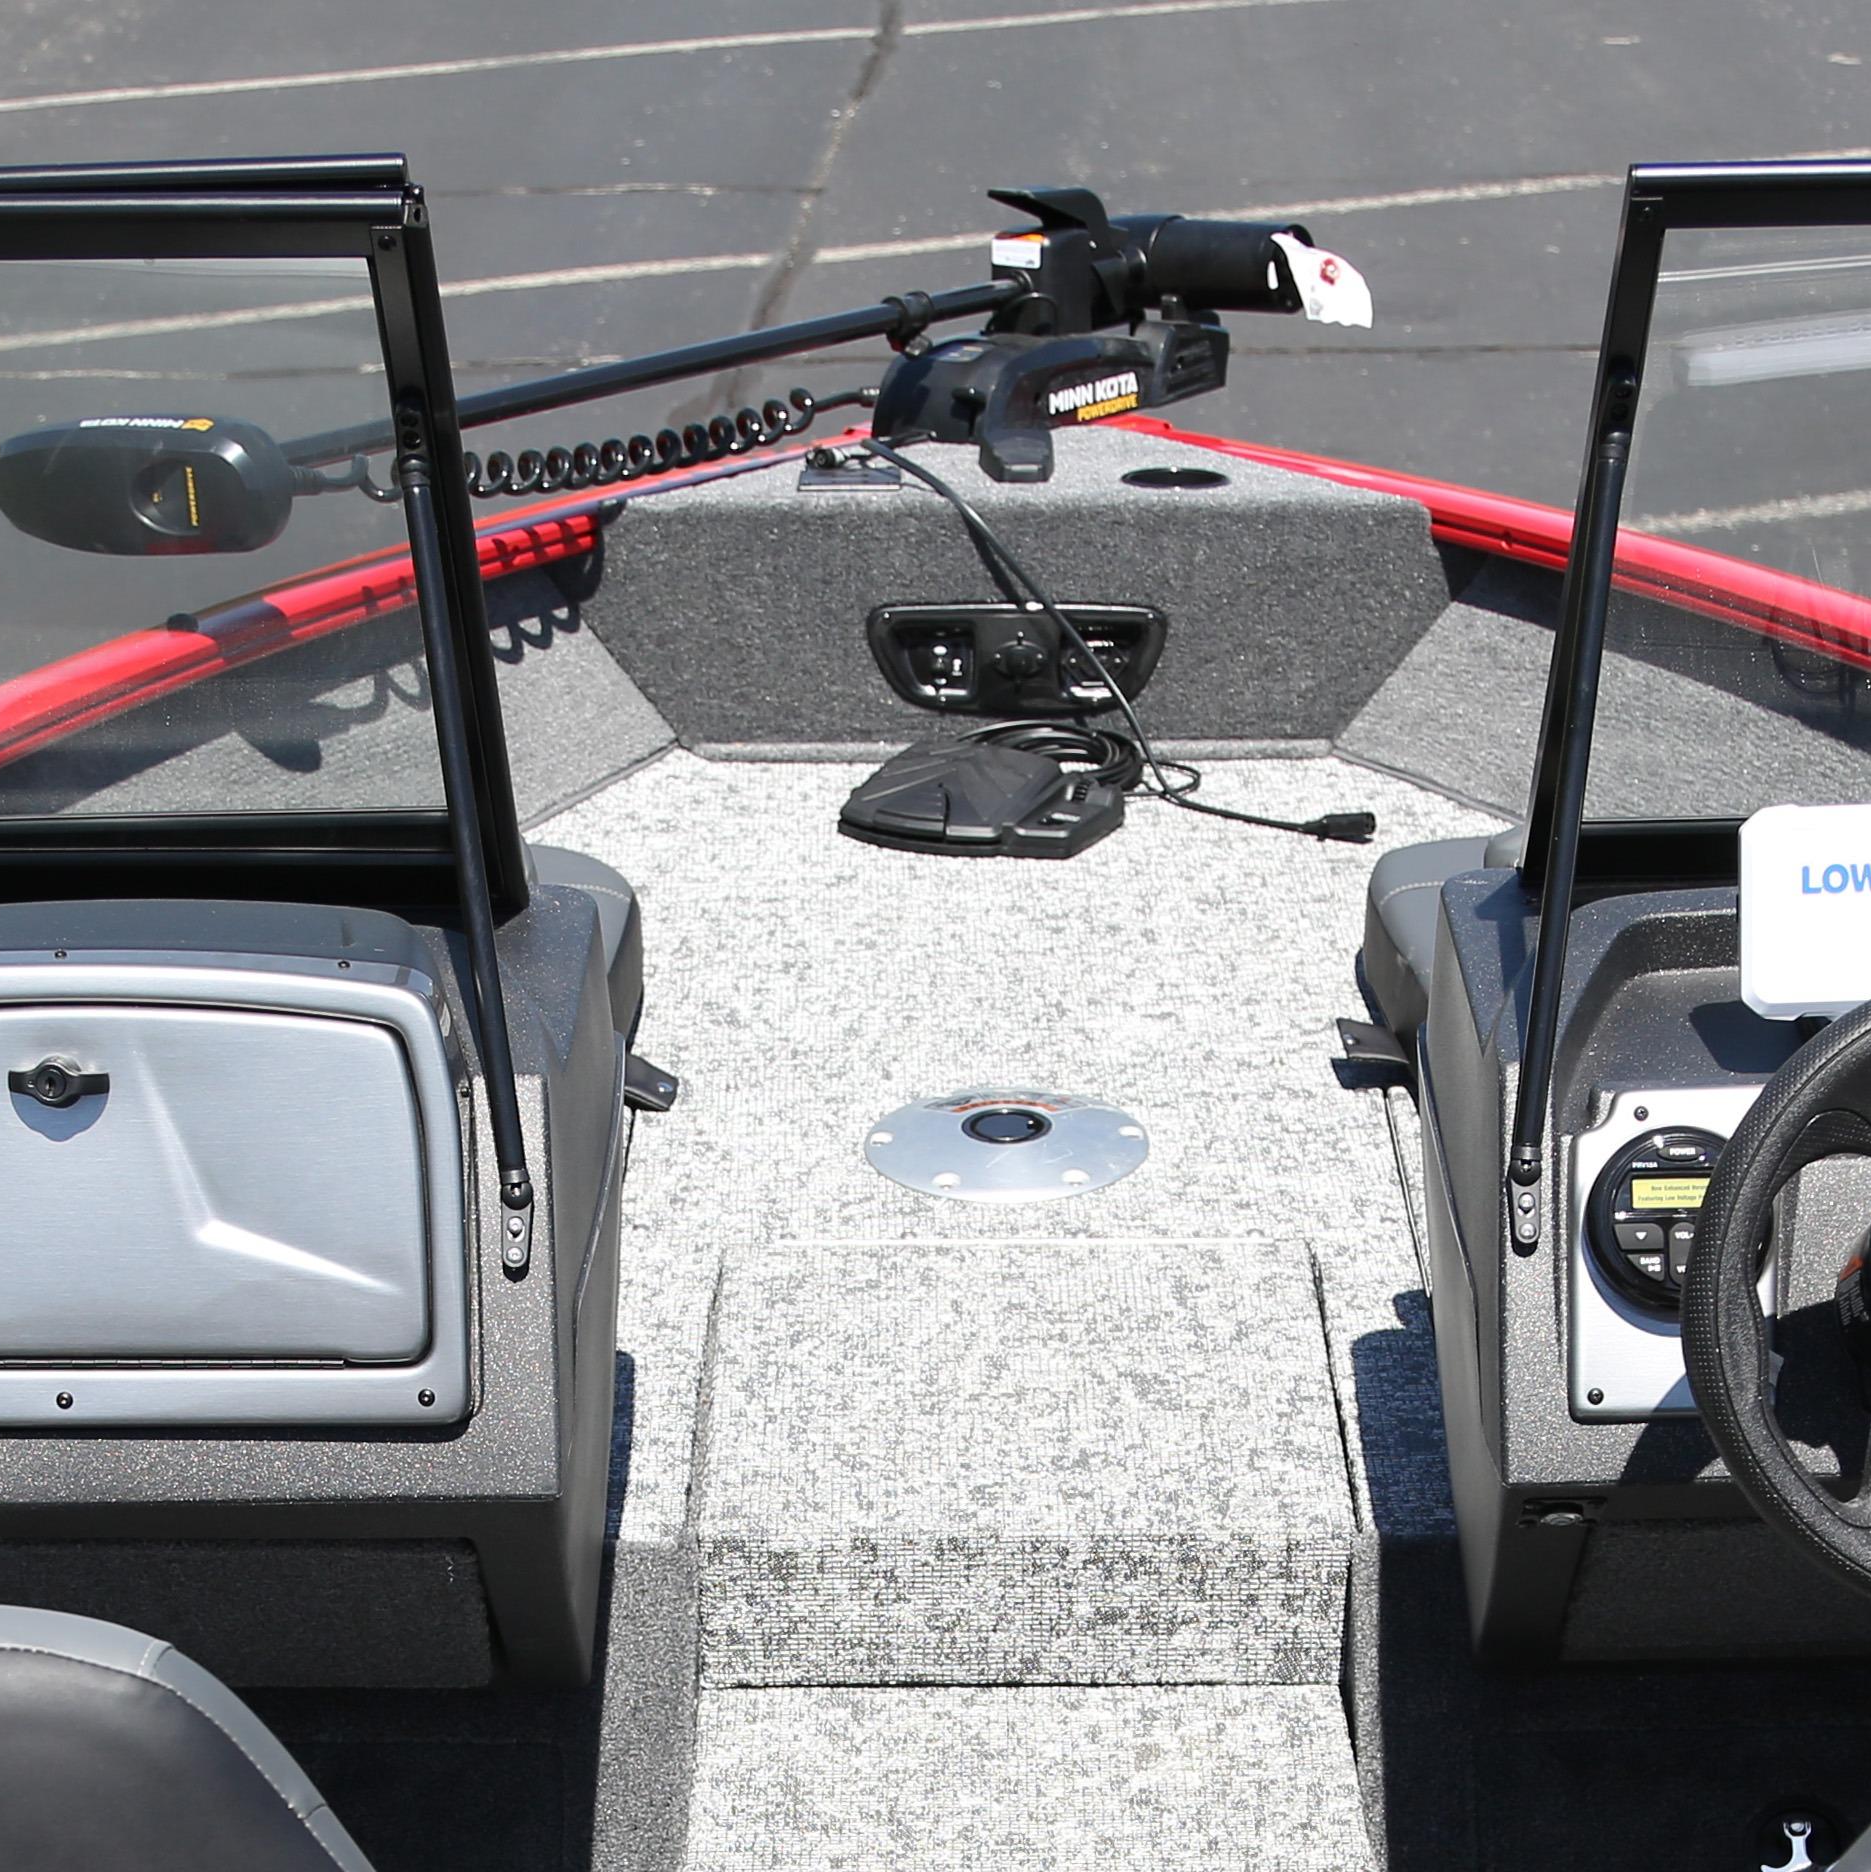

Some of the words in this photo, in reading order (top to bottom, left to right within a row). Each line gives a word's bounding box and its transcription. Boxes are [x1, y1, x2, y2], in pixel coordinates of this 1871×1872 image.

[1048, 382, 1094, 415] MINN
[1095, 371, 1139, 402] KOTA
[1077, 394, 1138, 422] POWERDRIVE
[129, 418, 184, 429] MINN
[1669, 1147, 1696, 1156] POWER
[1640, 1256, 1661, 1264] BAND
